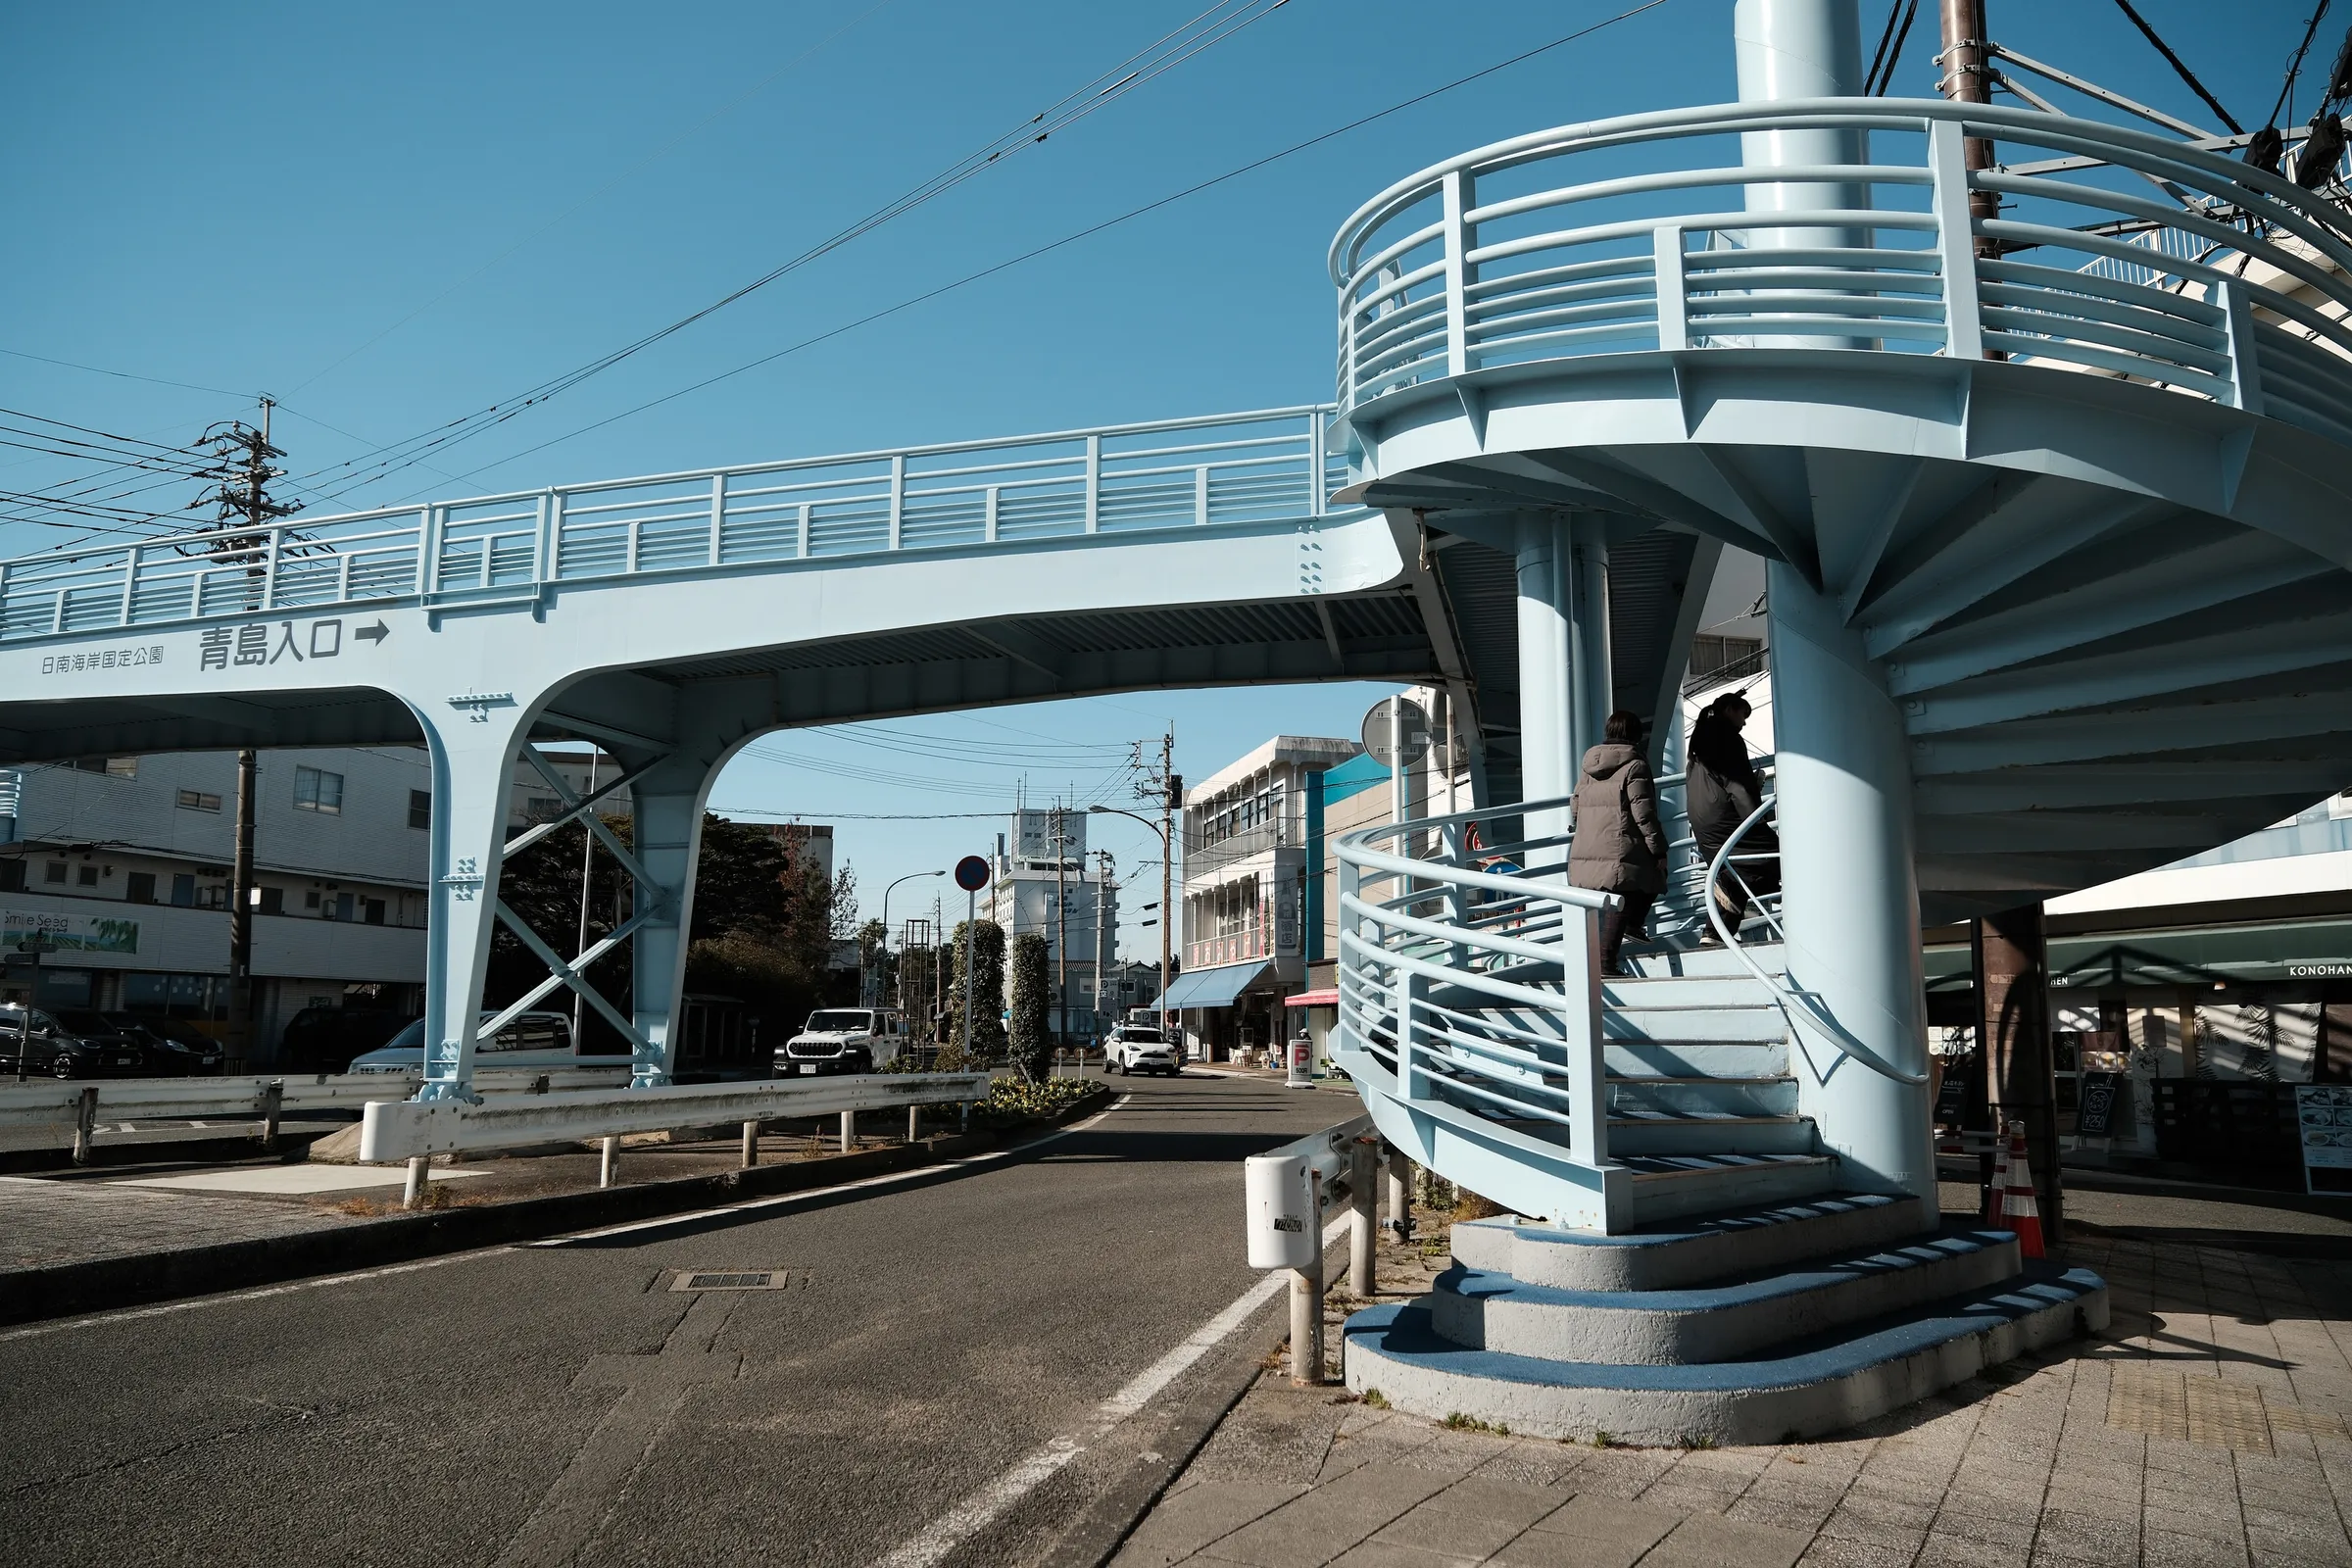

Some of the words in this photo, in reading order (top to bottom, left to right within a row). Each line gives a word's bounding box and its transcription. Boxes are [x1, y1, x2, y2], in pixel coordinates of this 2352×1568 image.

[199, 618, 343, 672] 青島入口
[41, 645, 165, 675] 日南海岸国定公園
[36, 913, 69, 929] Seed
[2289, 964, 2352, 977] KONOHAN
[1294, 1048, 1310, 1066] P
